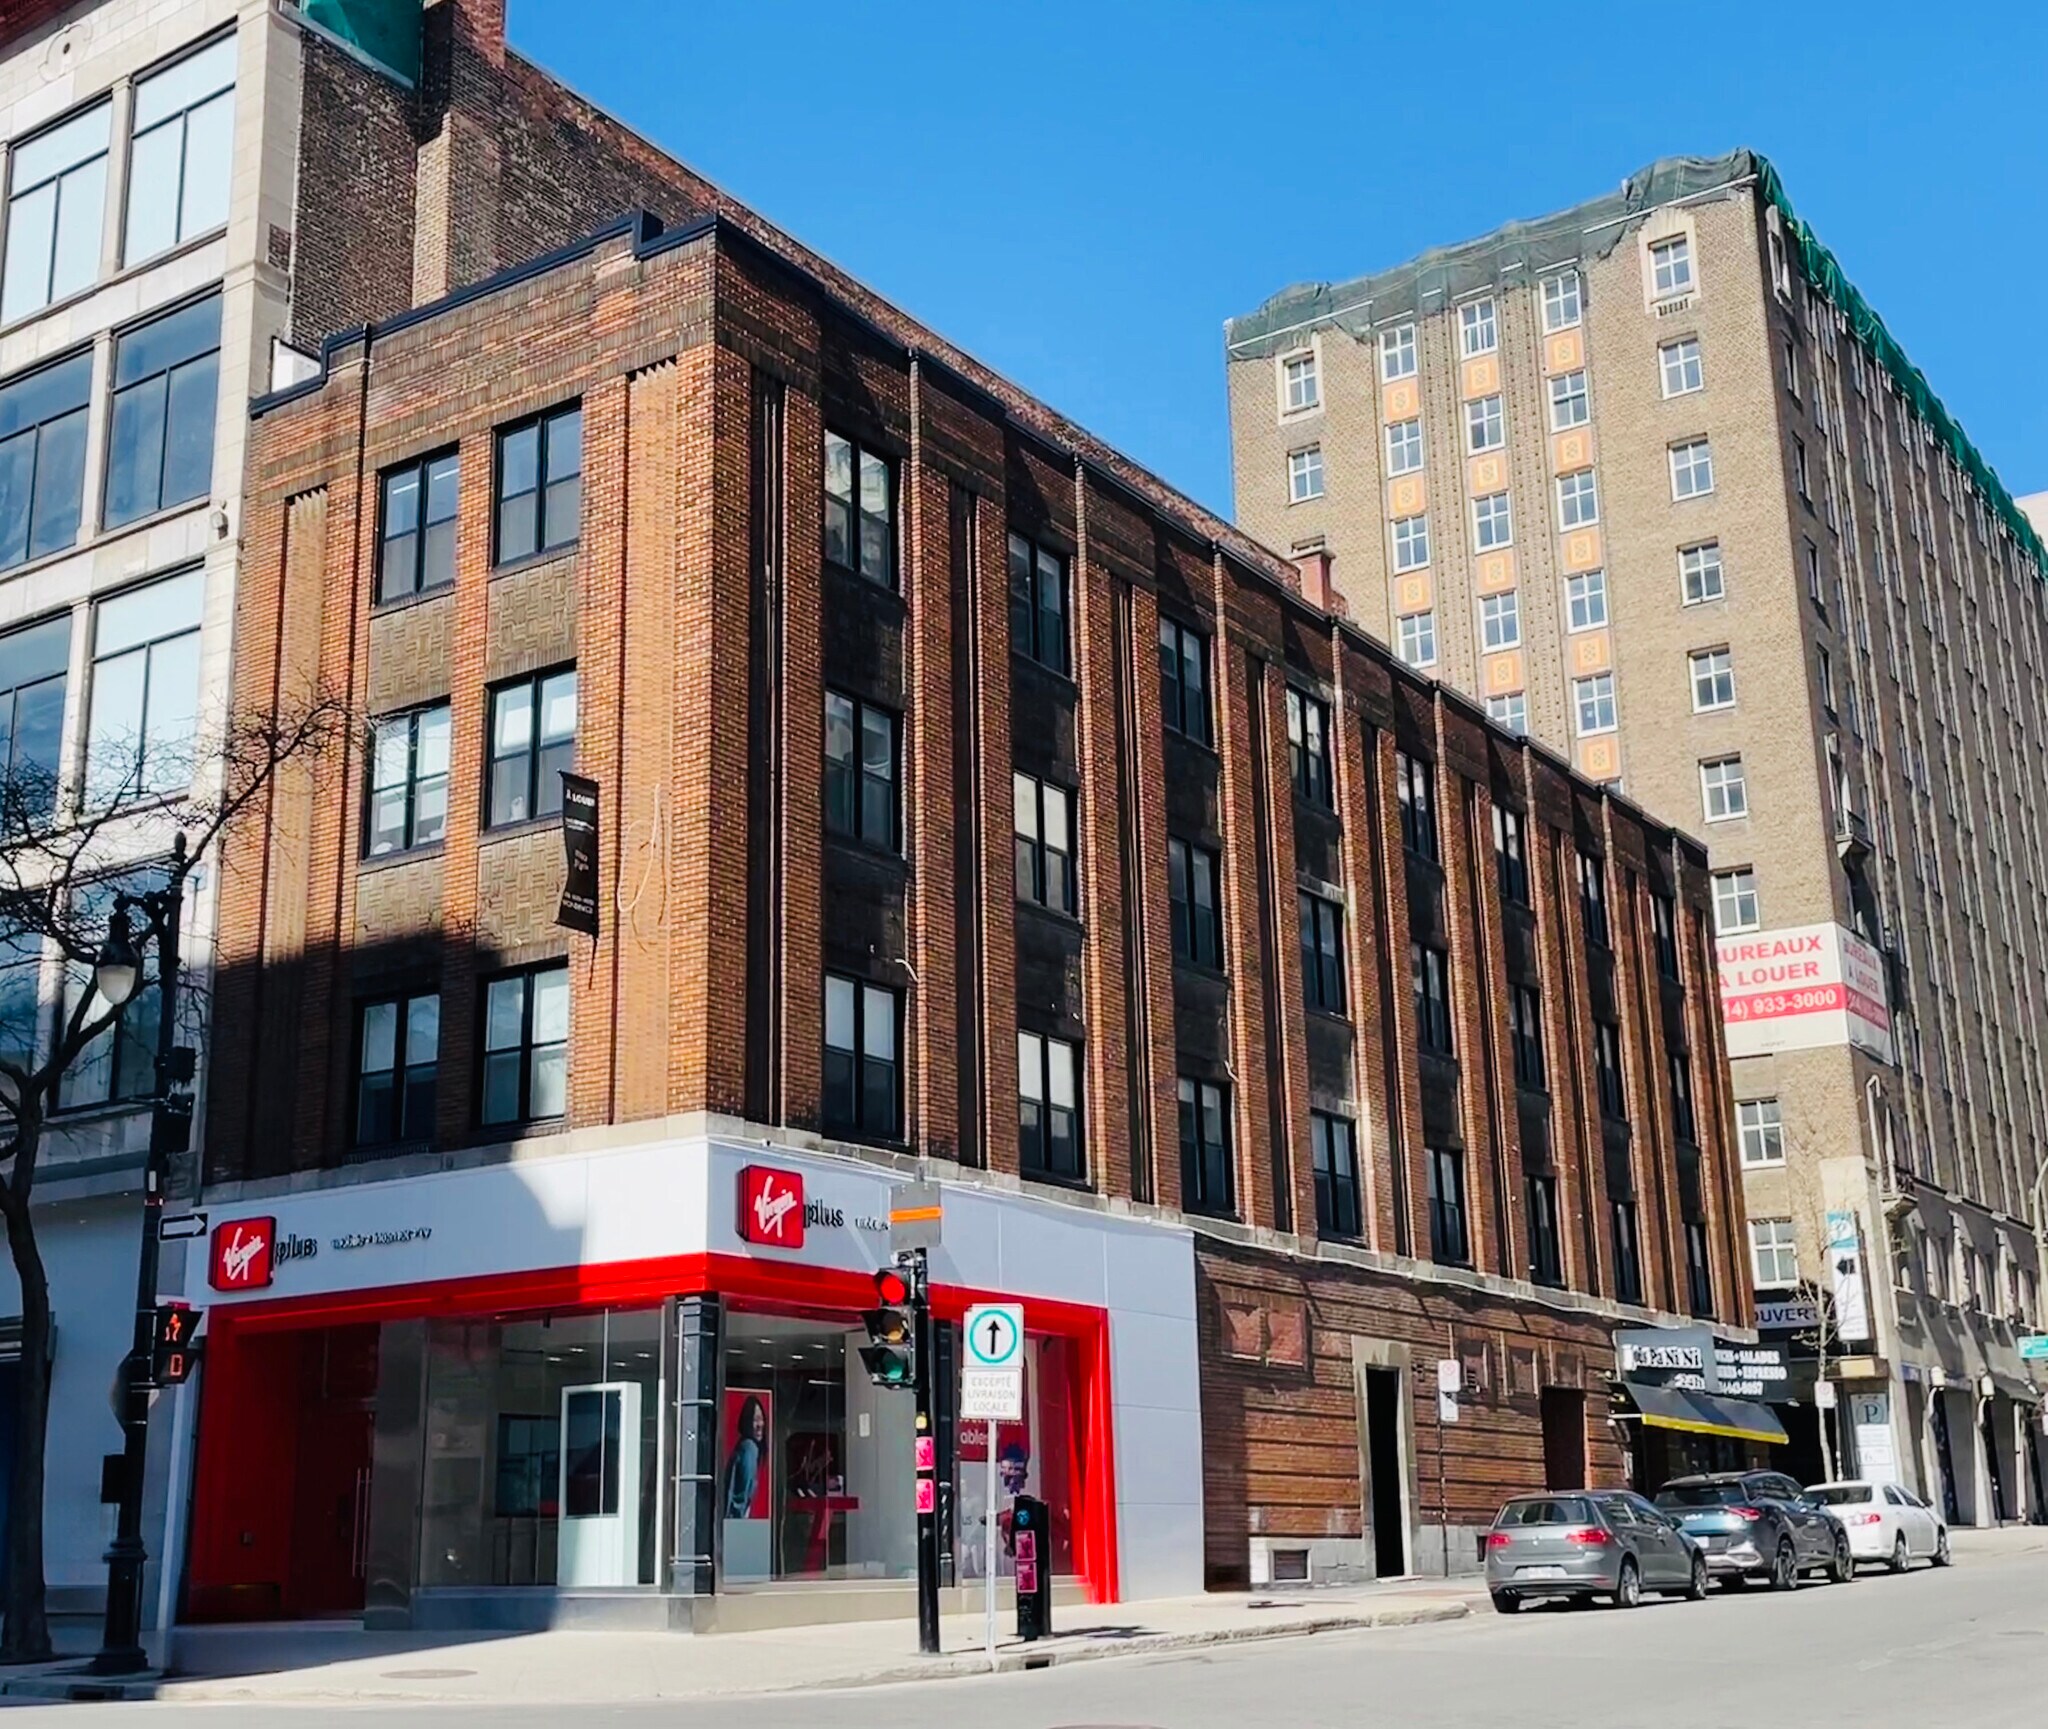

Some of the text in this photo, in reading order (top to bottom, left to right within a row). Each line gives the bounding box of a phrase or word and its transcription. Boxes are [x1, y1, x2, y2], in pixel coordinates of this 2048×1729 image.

[1722, 935, 1822, 963] UREAUX
[1738, 962, 1819, 986] LOUER
[1753, 988, 1838, 1015] 933-3000
[753, 1175, 798, 1238] Virgin
[803, 1199, 844, 1229] plus
[222, 1227, 265, 1281] Virgin
[967, 1389, 1016, 1400] LIVRAISON
[973, 1401, 1009, 1412] LOCALE
